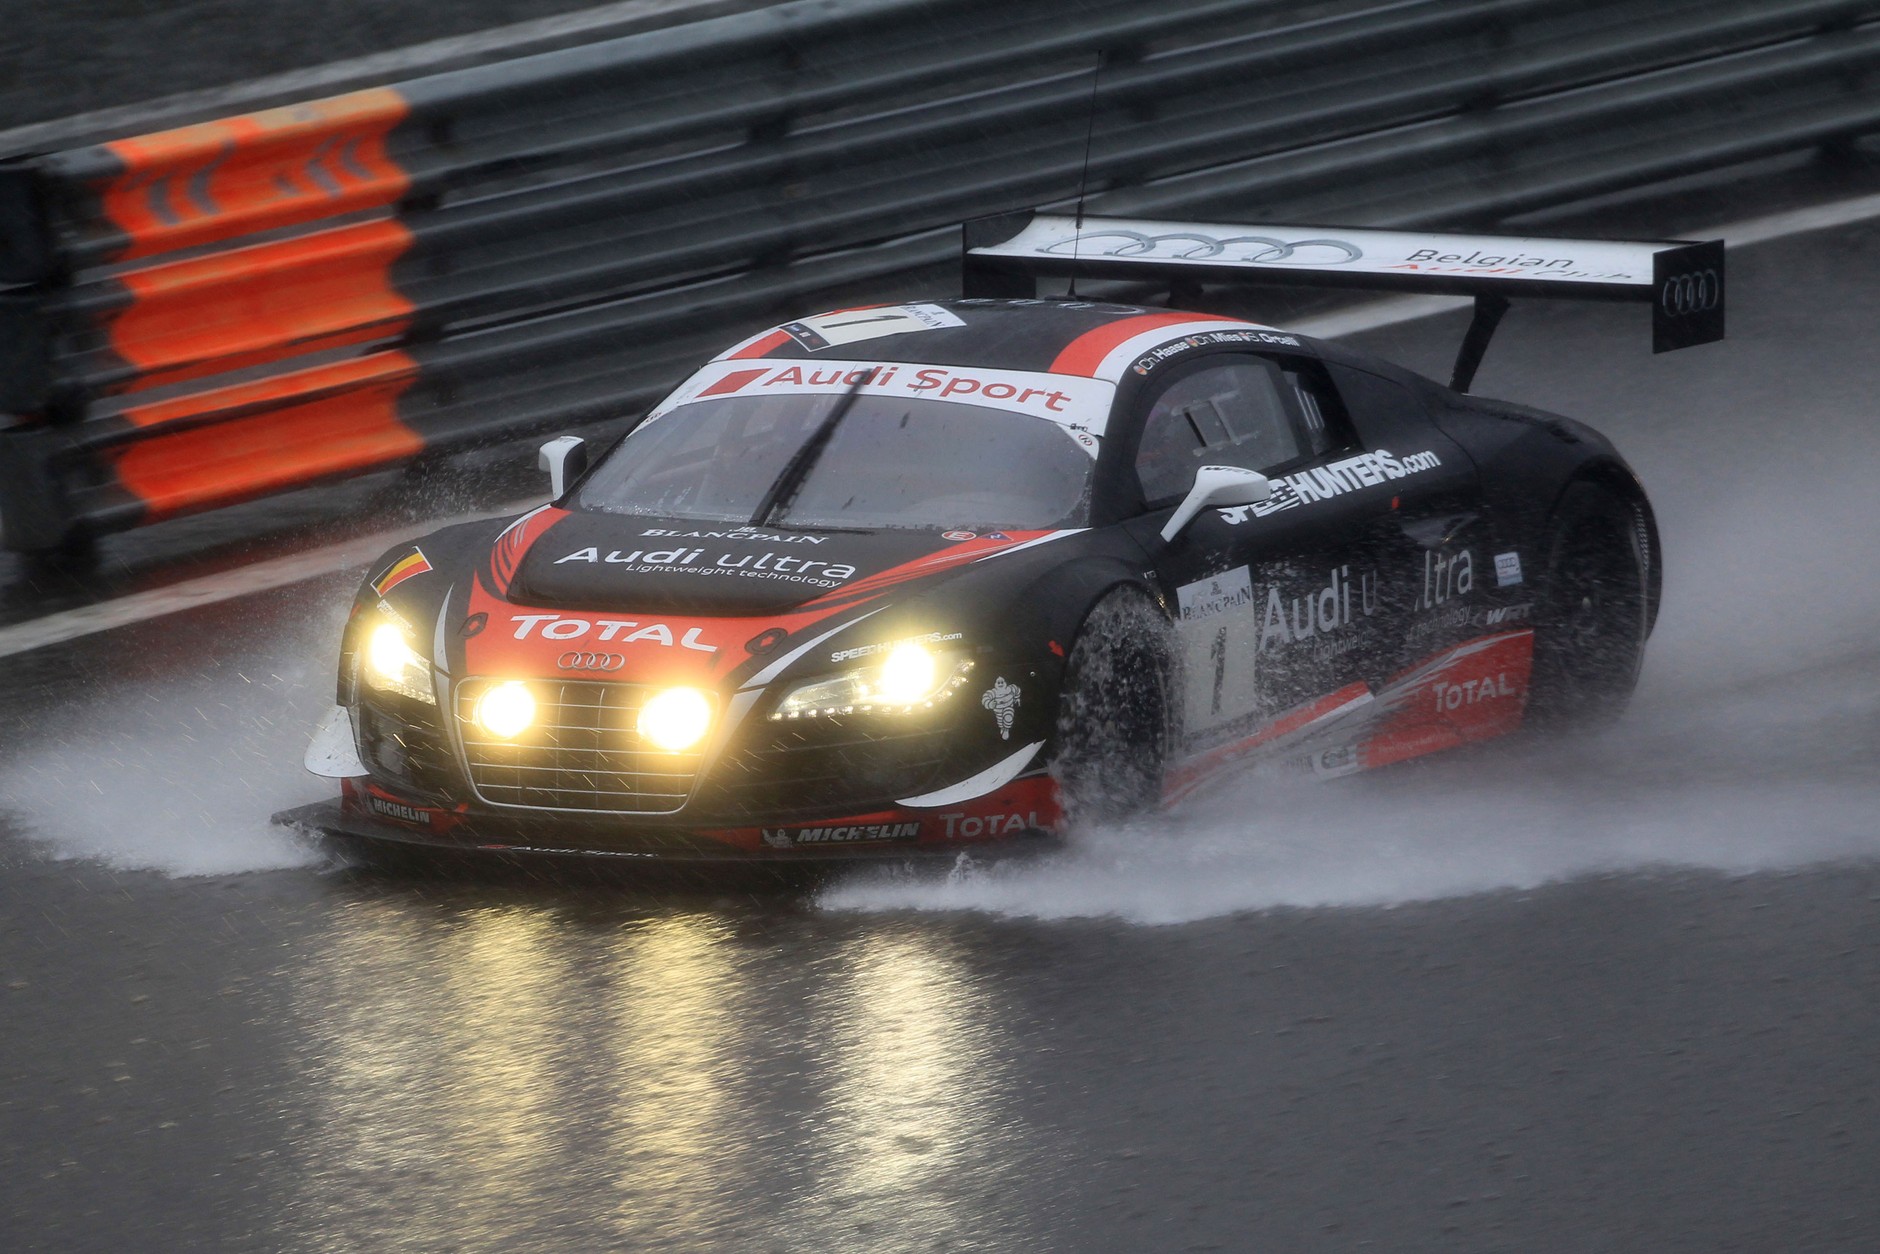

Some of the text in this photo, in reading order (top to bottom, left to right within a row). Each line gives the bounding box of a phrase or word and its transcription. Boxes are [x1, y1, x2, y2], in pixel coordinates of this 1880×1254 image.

[1405, 249, 1574, 268] Belgian
[1157, 341, 1190, 360] Haase
[763, 366, 1072, 412] Audi Sport
[638, 528, 829, 544] BLANCPAIN
[554, 547, 856, 579] Audi ultra
[625, 563, 842, 588] Lightweight technology
[1257, 565, 1349, 656] Audi
[510, 614, 717, 653] TOTAL
[1210, 626, 1227, 715] 1
[1432, 673, 1516, 713] TOTAL
[373, 799, 430, 824] MICHELIN
[797, 811, 1054, 843] MICHELIN TOTAL
